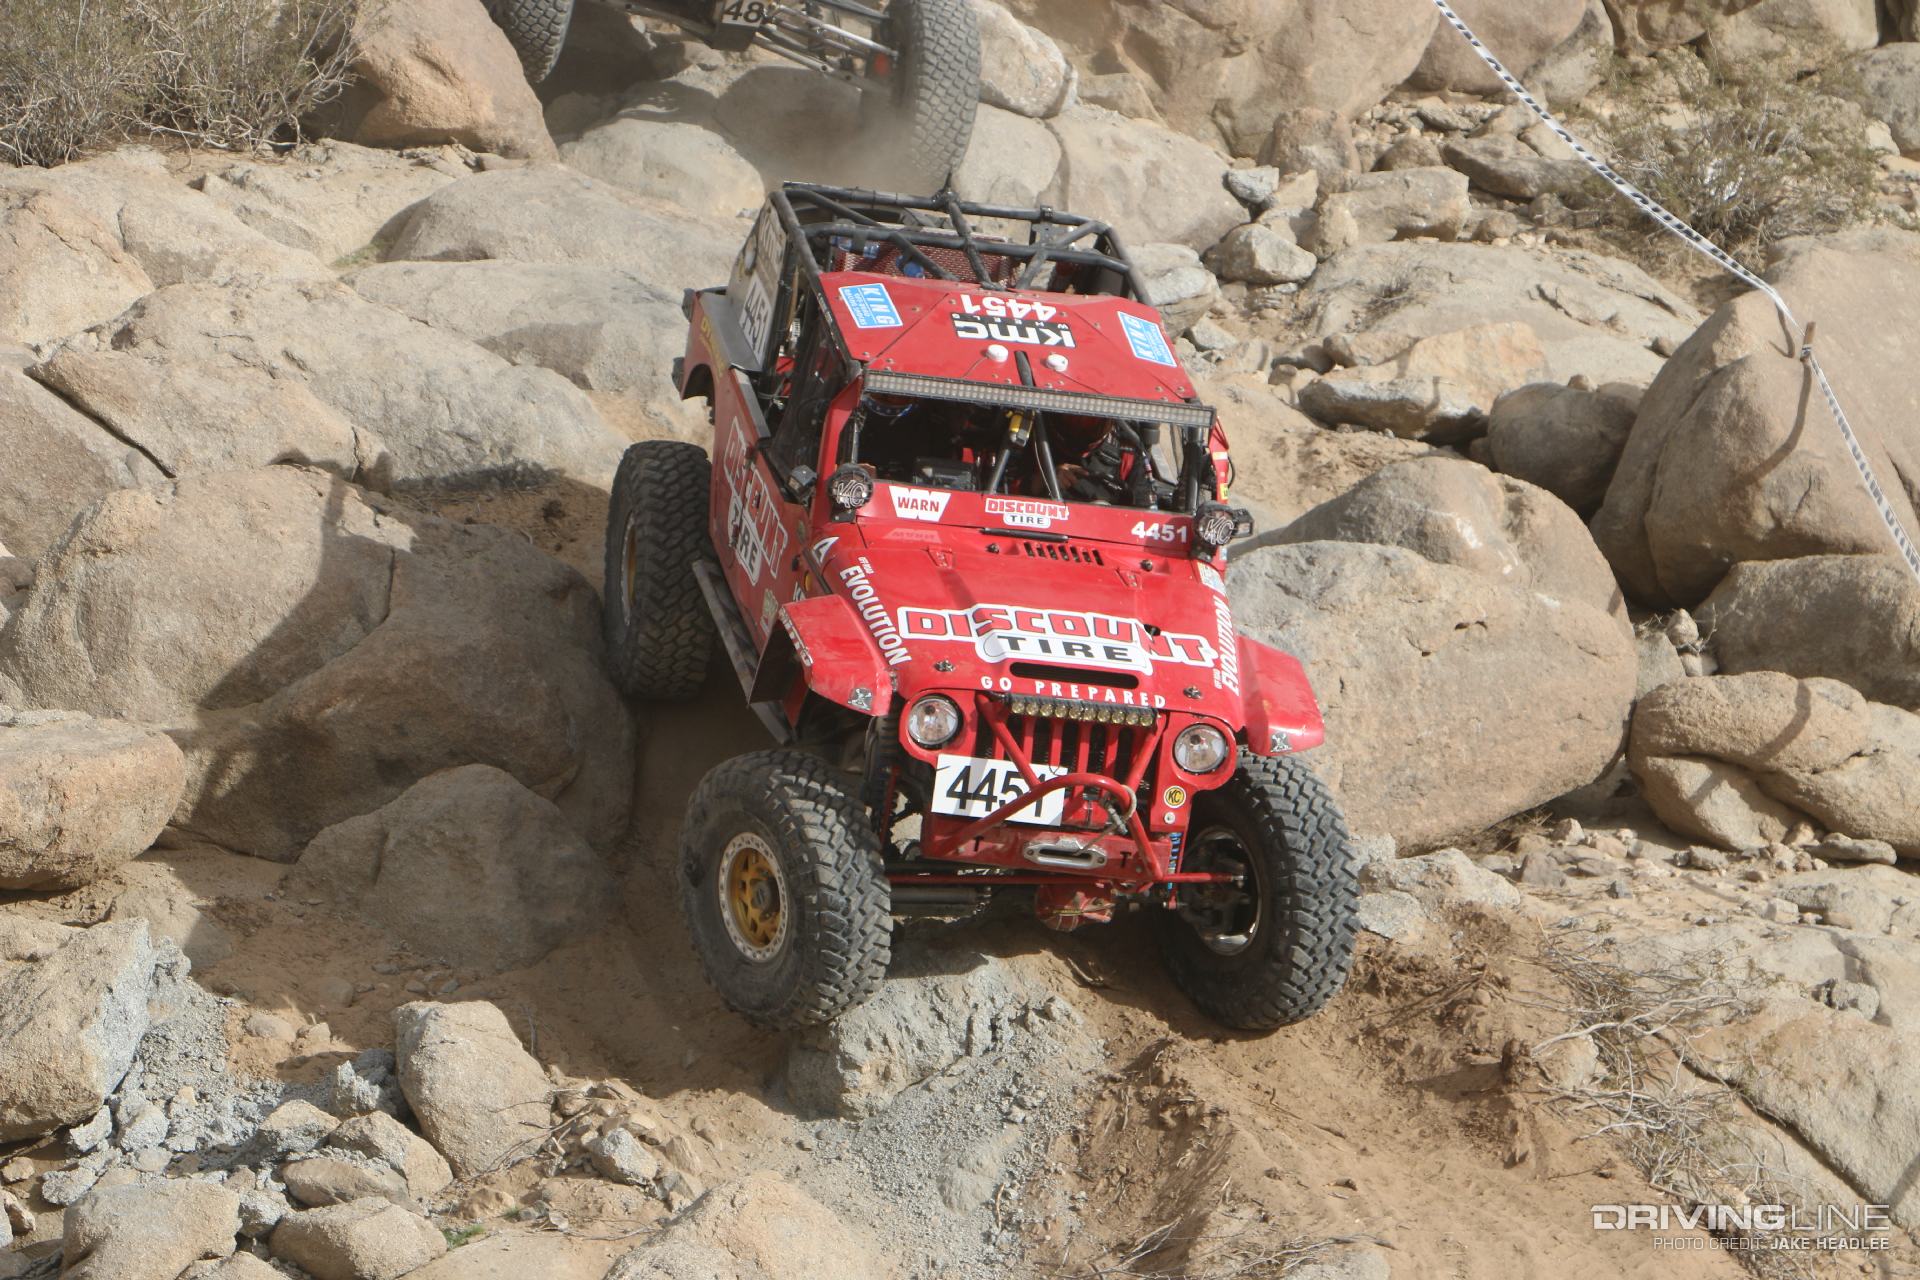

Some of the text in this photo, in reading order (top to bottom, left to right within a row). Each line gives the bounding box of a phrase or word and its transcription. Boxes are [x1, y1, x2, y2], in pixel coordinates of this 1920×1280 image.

[861, 287, 896, 325] KING
[960, 294, 1057, 321] 4451
[837, 480, 865, 508] KC
[898, 496, 940, 513] WARN
[987, 500, 1068, 519] DISCOUNT
[1010, 515, 1044, 525] TIRE
[1131, 521, 1188, 543] 4451
[1204, 516, 1234, 545] KC
[840, 565, 912, 666] EVOLUTION
[905, 606, 1212, 664] DISCOUNT
[997, 635, 1133, 663] TIRE
[1213, 595, 1239, 696] EVOLUTION
[981, 676, 1166, 708] GO PREPARED
[946, 765, 1047, 818] 4451
[1168, 789, 1182, 804] KC
